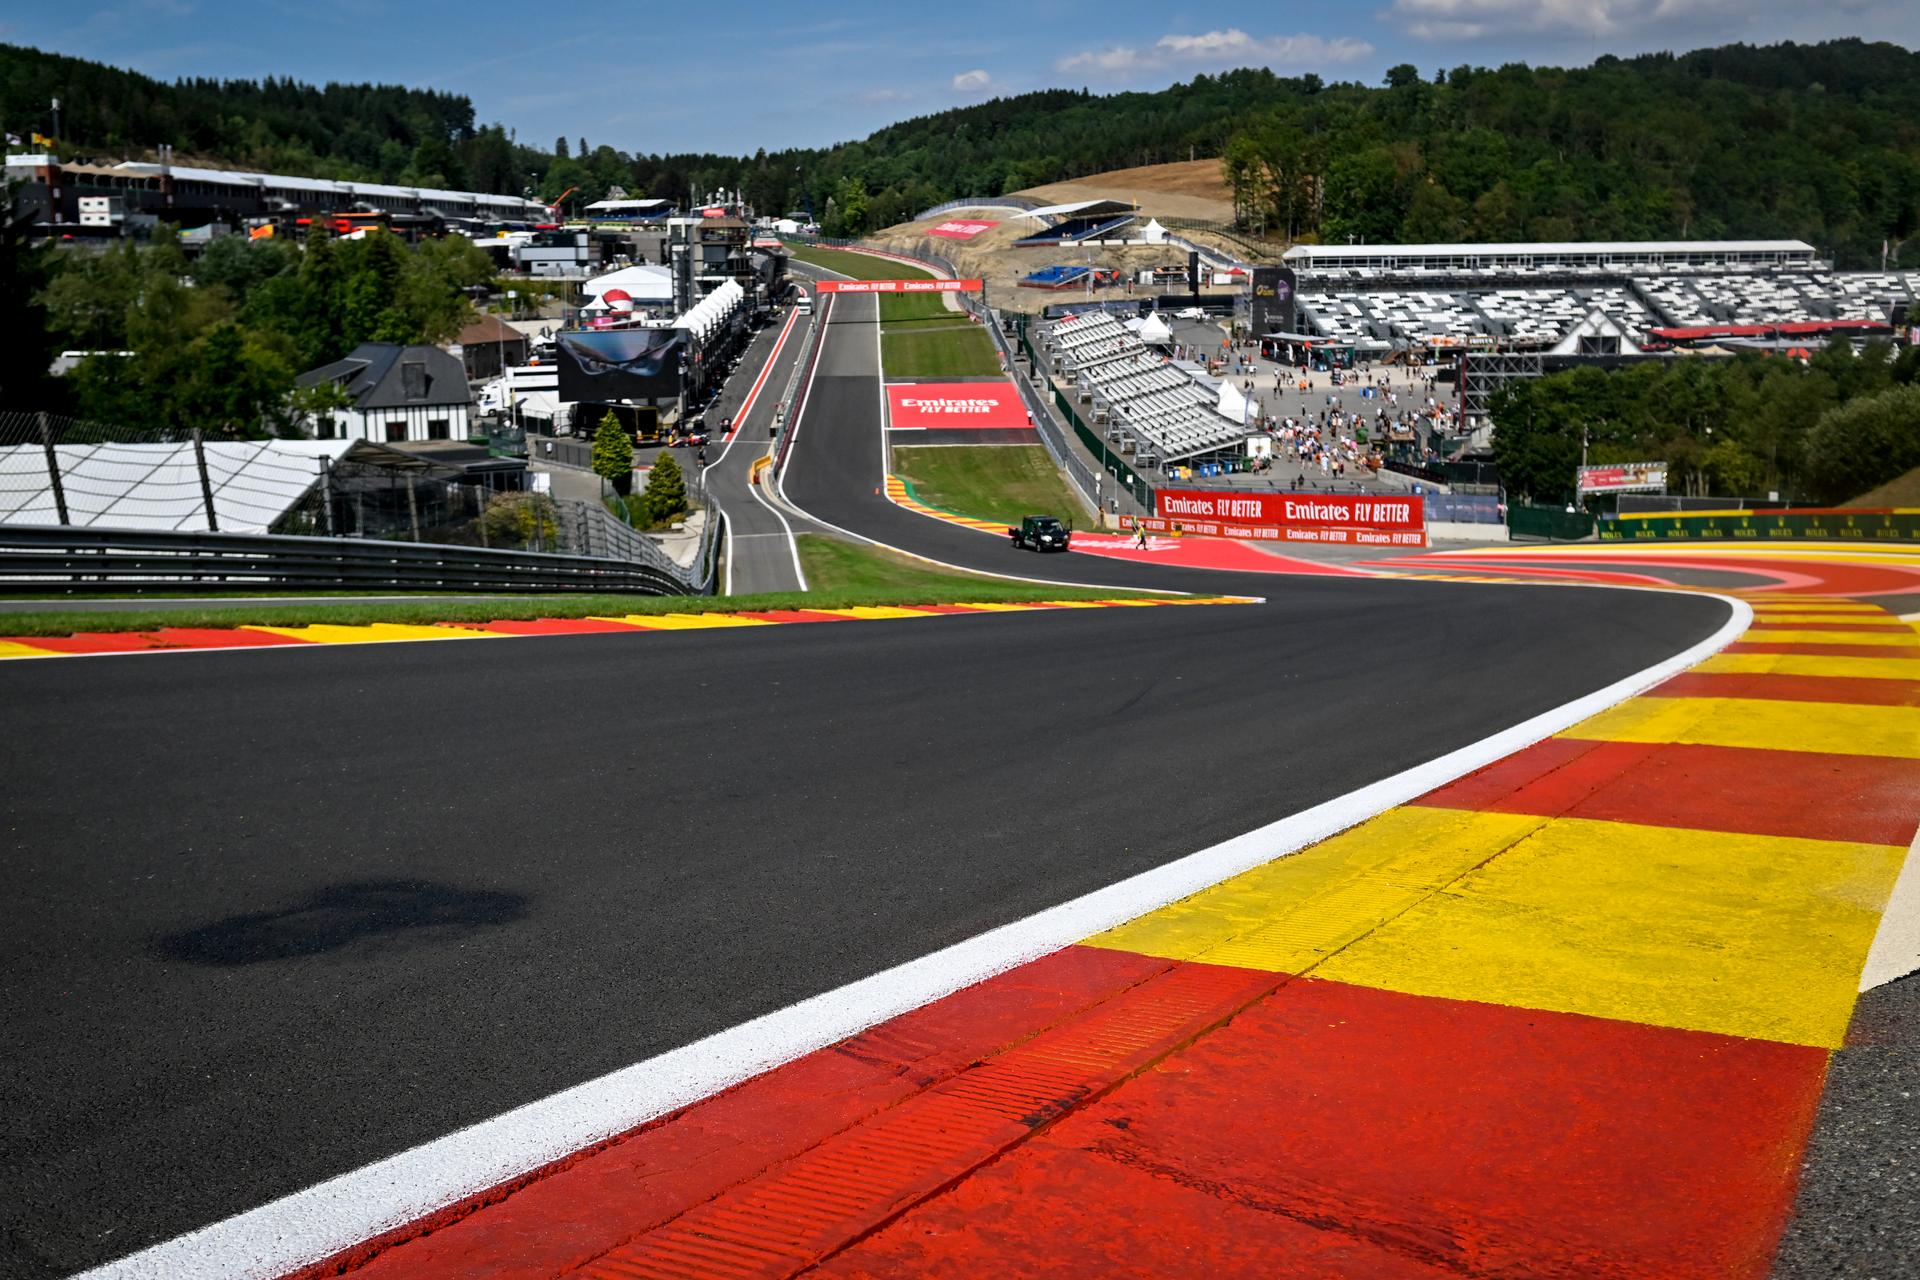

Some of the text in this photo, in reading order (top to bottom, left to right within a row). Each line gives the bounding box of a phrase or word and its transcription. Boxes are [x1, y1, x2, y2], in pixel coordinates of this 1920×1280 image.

[900, 398, 999, 406] Emirates
[1164, 496, 1262, 517] Emirates FLY BETTER
[1285, 501, 1410, 522] Emirates FLY BETTER
[1153, 520, 1165, 529] BETTER
[1204, 525, 1217, 534] BETTER
[1224, 526, 1278, 538] Emirates FLY BETTER
[1287, 529, 1347, 542] Emirates FLY BETTER
[1356, 532, 1421, 544] Emirates FLY BETTER
[1601, 531, 1623, 539] ROLEX
